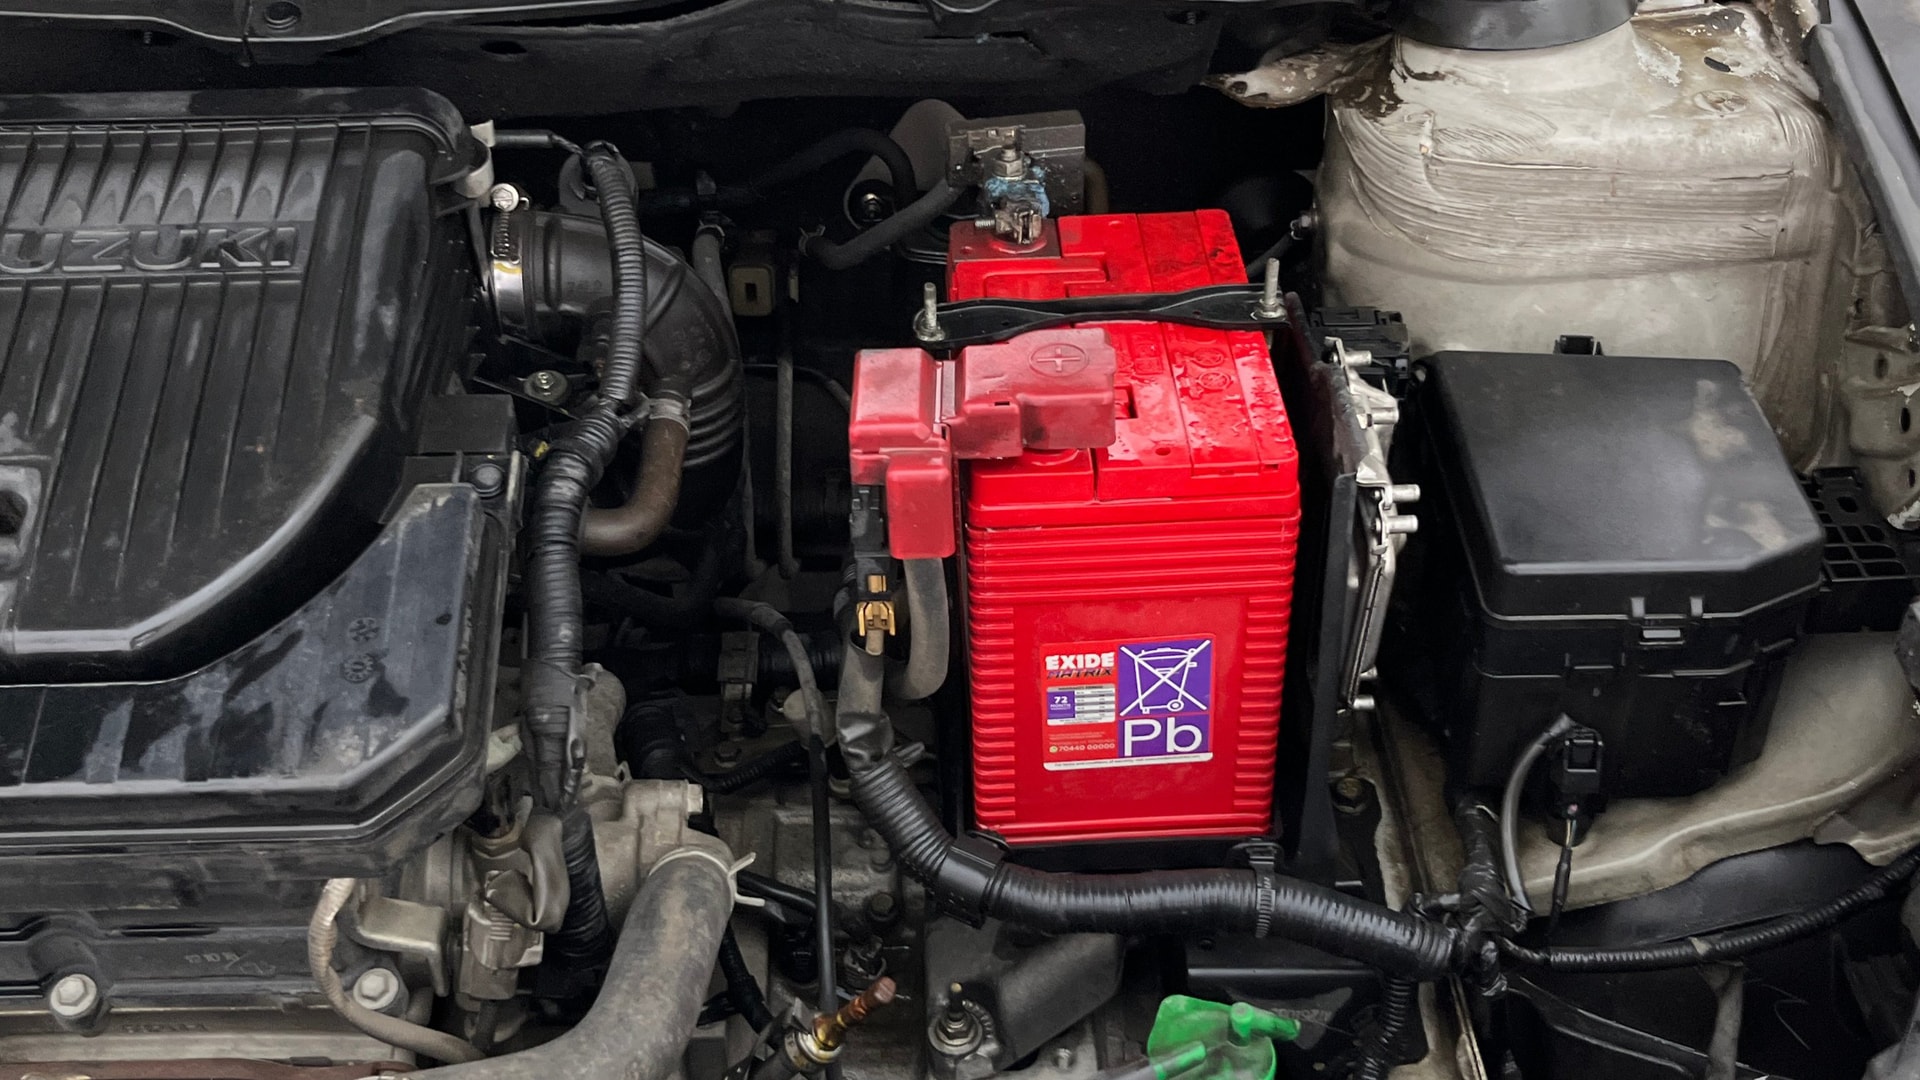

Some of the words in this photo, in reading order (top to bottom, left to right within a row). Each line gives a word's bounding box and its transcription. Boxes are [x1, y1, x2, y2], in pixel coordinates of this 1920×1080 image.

[1045, 652, 1115, 671] EXIDE
[1047, 668, 1112, 680] MATRIX
[1054, 696, 1068, 704] 72
[1124, 717, 1203, 757] Pb
